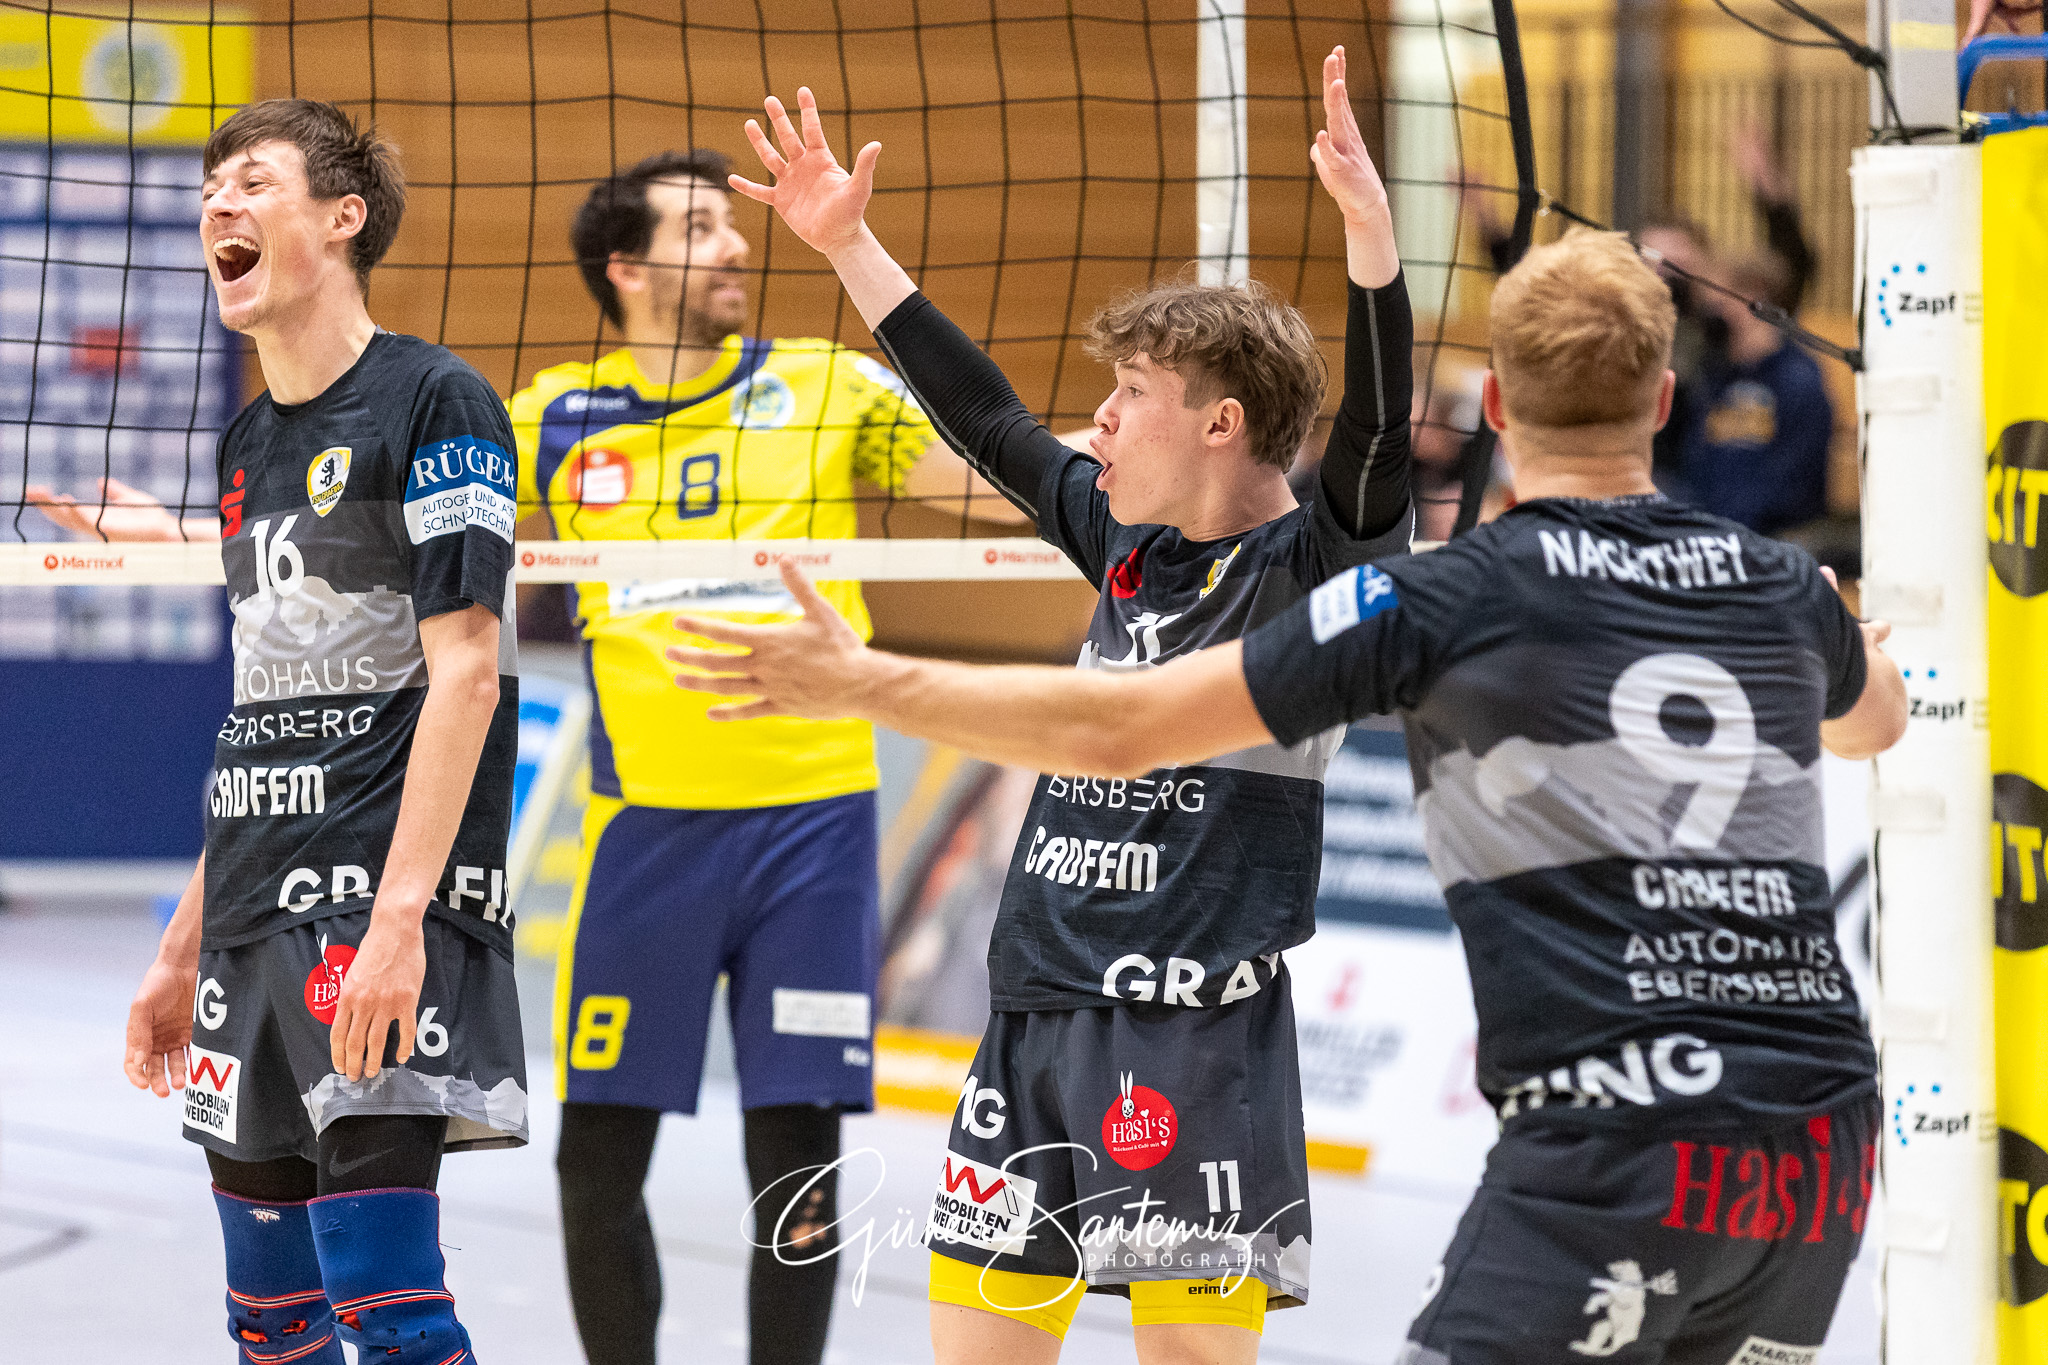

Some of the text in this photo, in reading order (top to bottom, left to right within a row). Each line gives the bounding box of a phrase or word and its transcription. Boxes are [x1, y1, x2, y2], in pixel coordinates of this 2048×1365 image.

[1898, 291, 1956, 317] Zapf
[475, 490, 497, 507] UND
[678, 453, 720, 520] 8
[60, 555, 125, 571] Marmot
[249, 514, 304, 601] 16
[538, 553, 599, 567] Marmot
[1537, 529, 1749, 591] NACHTWEY
[1909, 696, 1966, 722] Zapf
[1608, 652, 1757, 851] 9
[211, 764, 326, 818] CADFEM
[1024, 825, 1159, 893] CADFEM
[569, 994, 631, 1070] 8
[1111, 1109, 1171, 1144] Hasi's
[1913, 1111, 1971, 1138] Zapf
[1199, 1160, 1242, 1213] 11
[1188, 1282, 1230, 1296] erima
